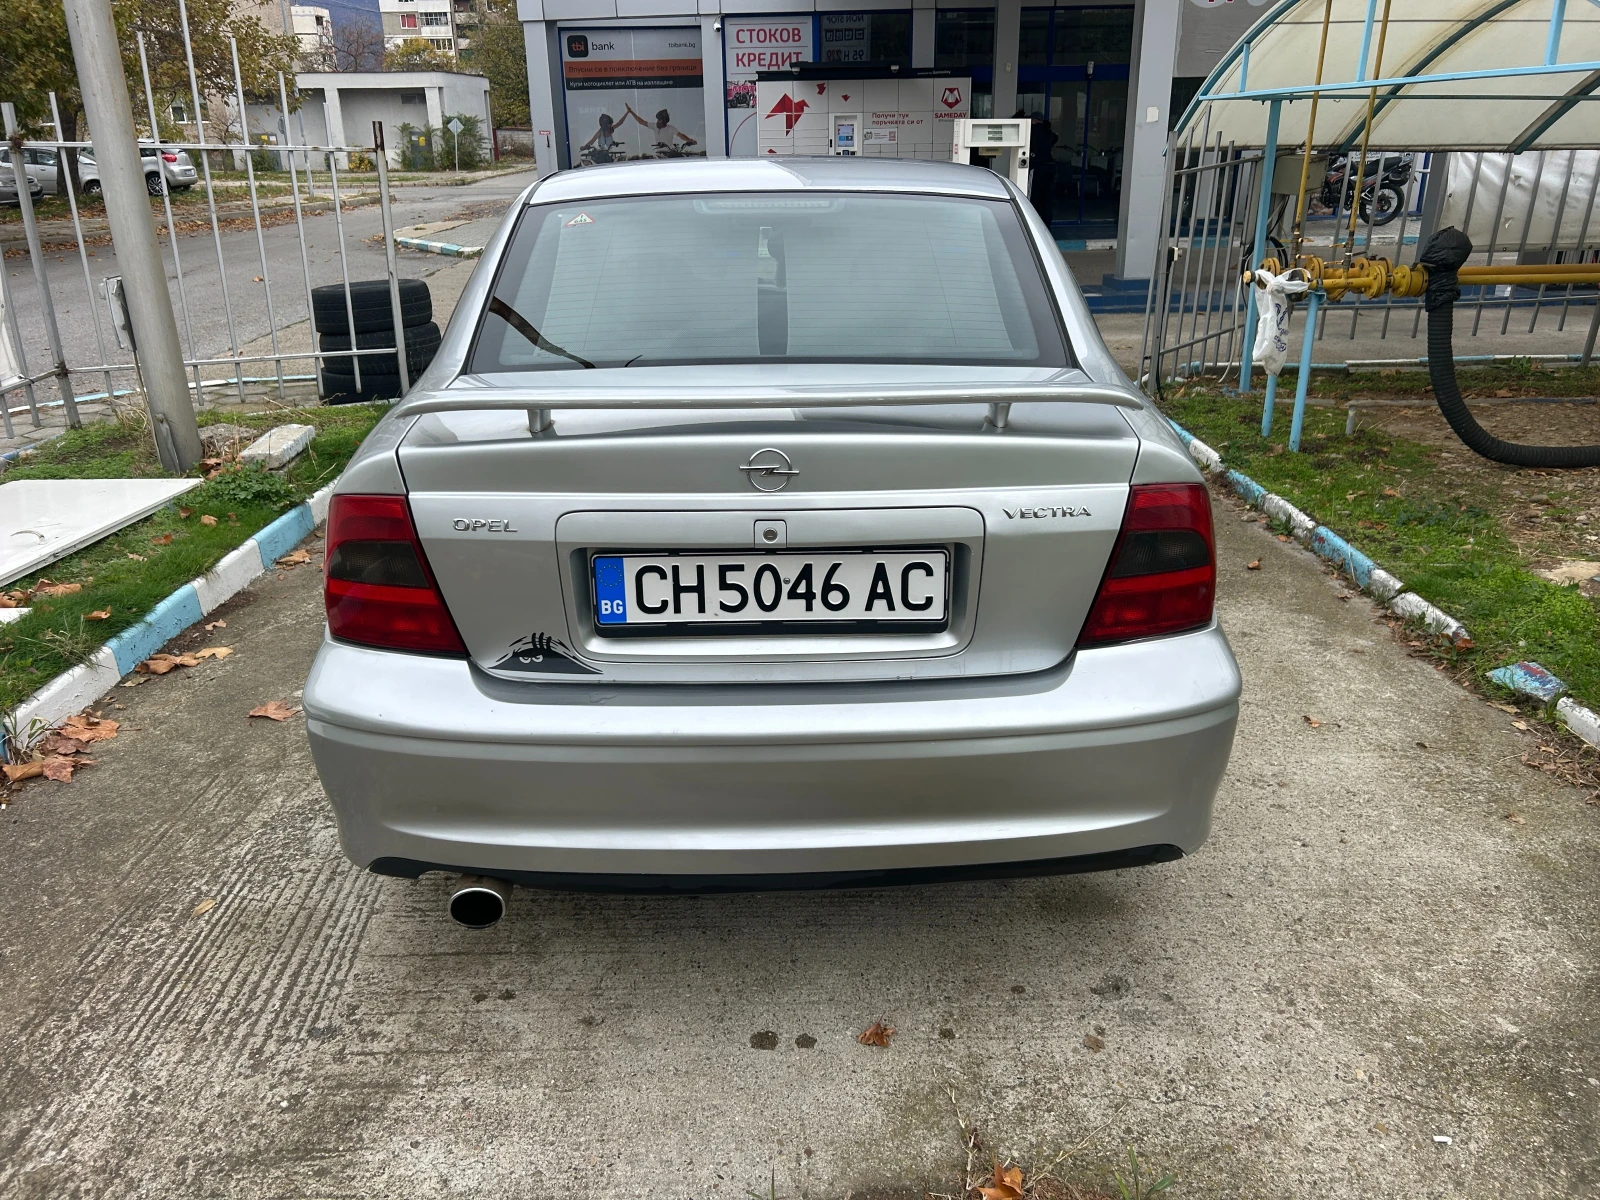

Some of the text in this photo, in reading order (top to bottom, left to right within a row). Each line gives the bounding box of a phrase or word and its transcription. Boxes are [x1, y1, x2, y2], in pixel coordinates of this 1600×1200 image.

[735, 28, 802, 44] СТОКОВ
[571, 42, 615, 51] tbi bank
[735, 52, 802, 70] КРЕДИТ
[568, 66, 594, 74] Впусни
[609, 65, 655, 74] приключение
[669, 64, 697, 72] граници
[1002, 505, 1092, 520] VECTRA
[452, 518, 519, 533] OPEL
[718, 562, 850, 614] 5046
[601, 600, 624, 615] BG
